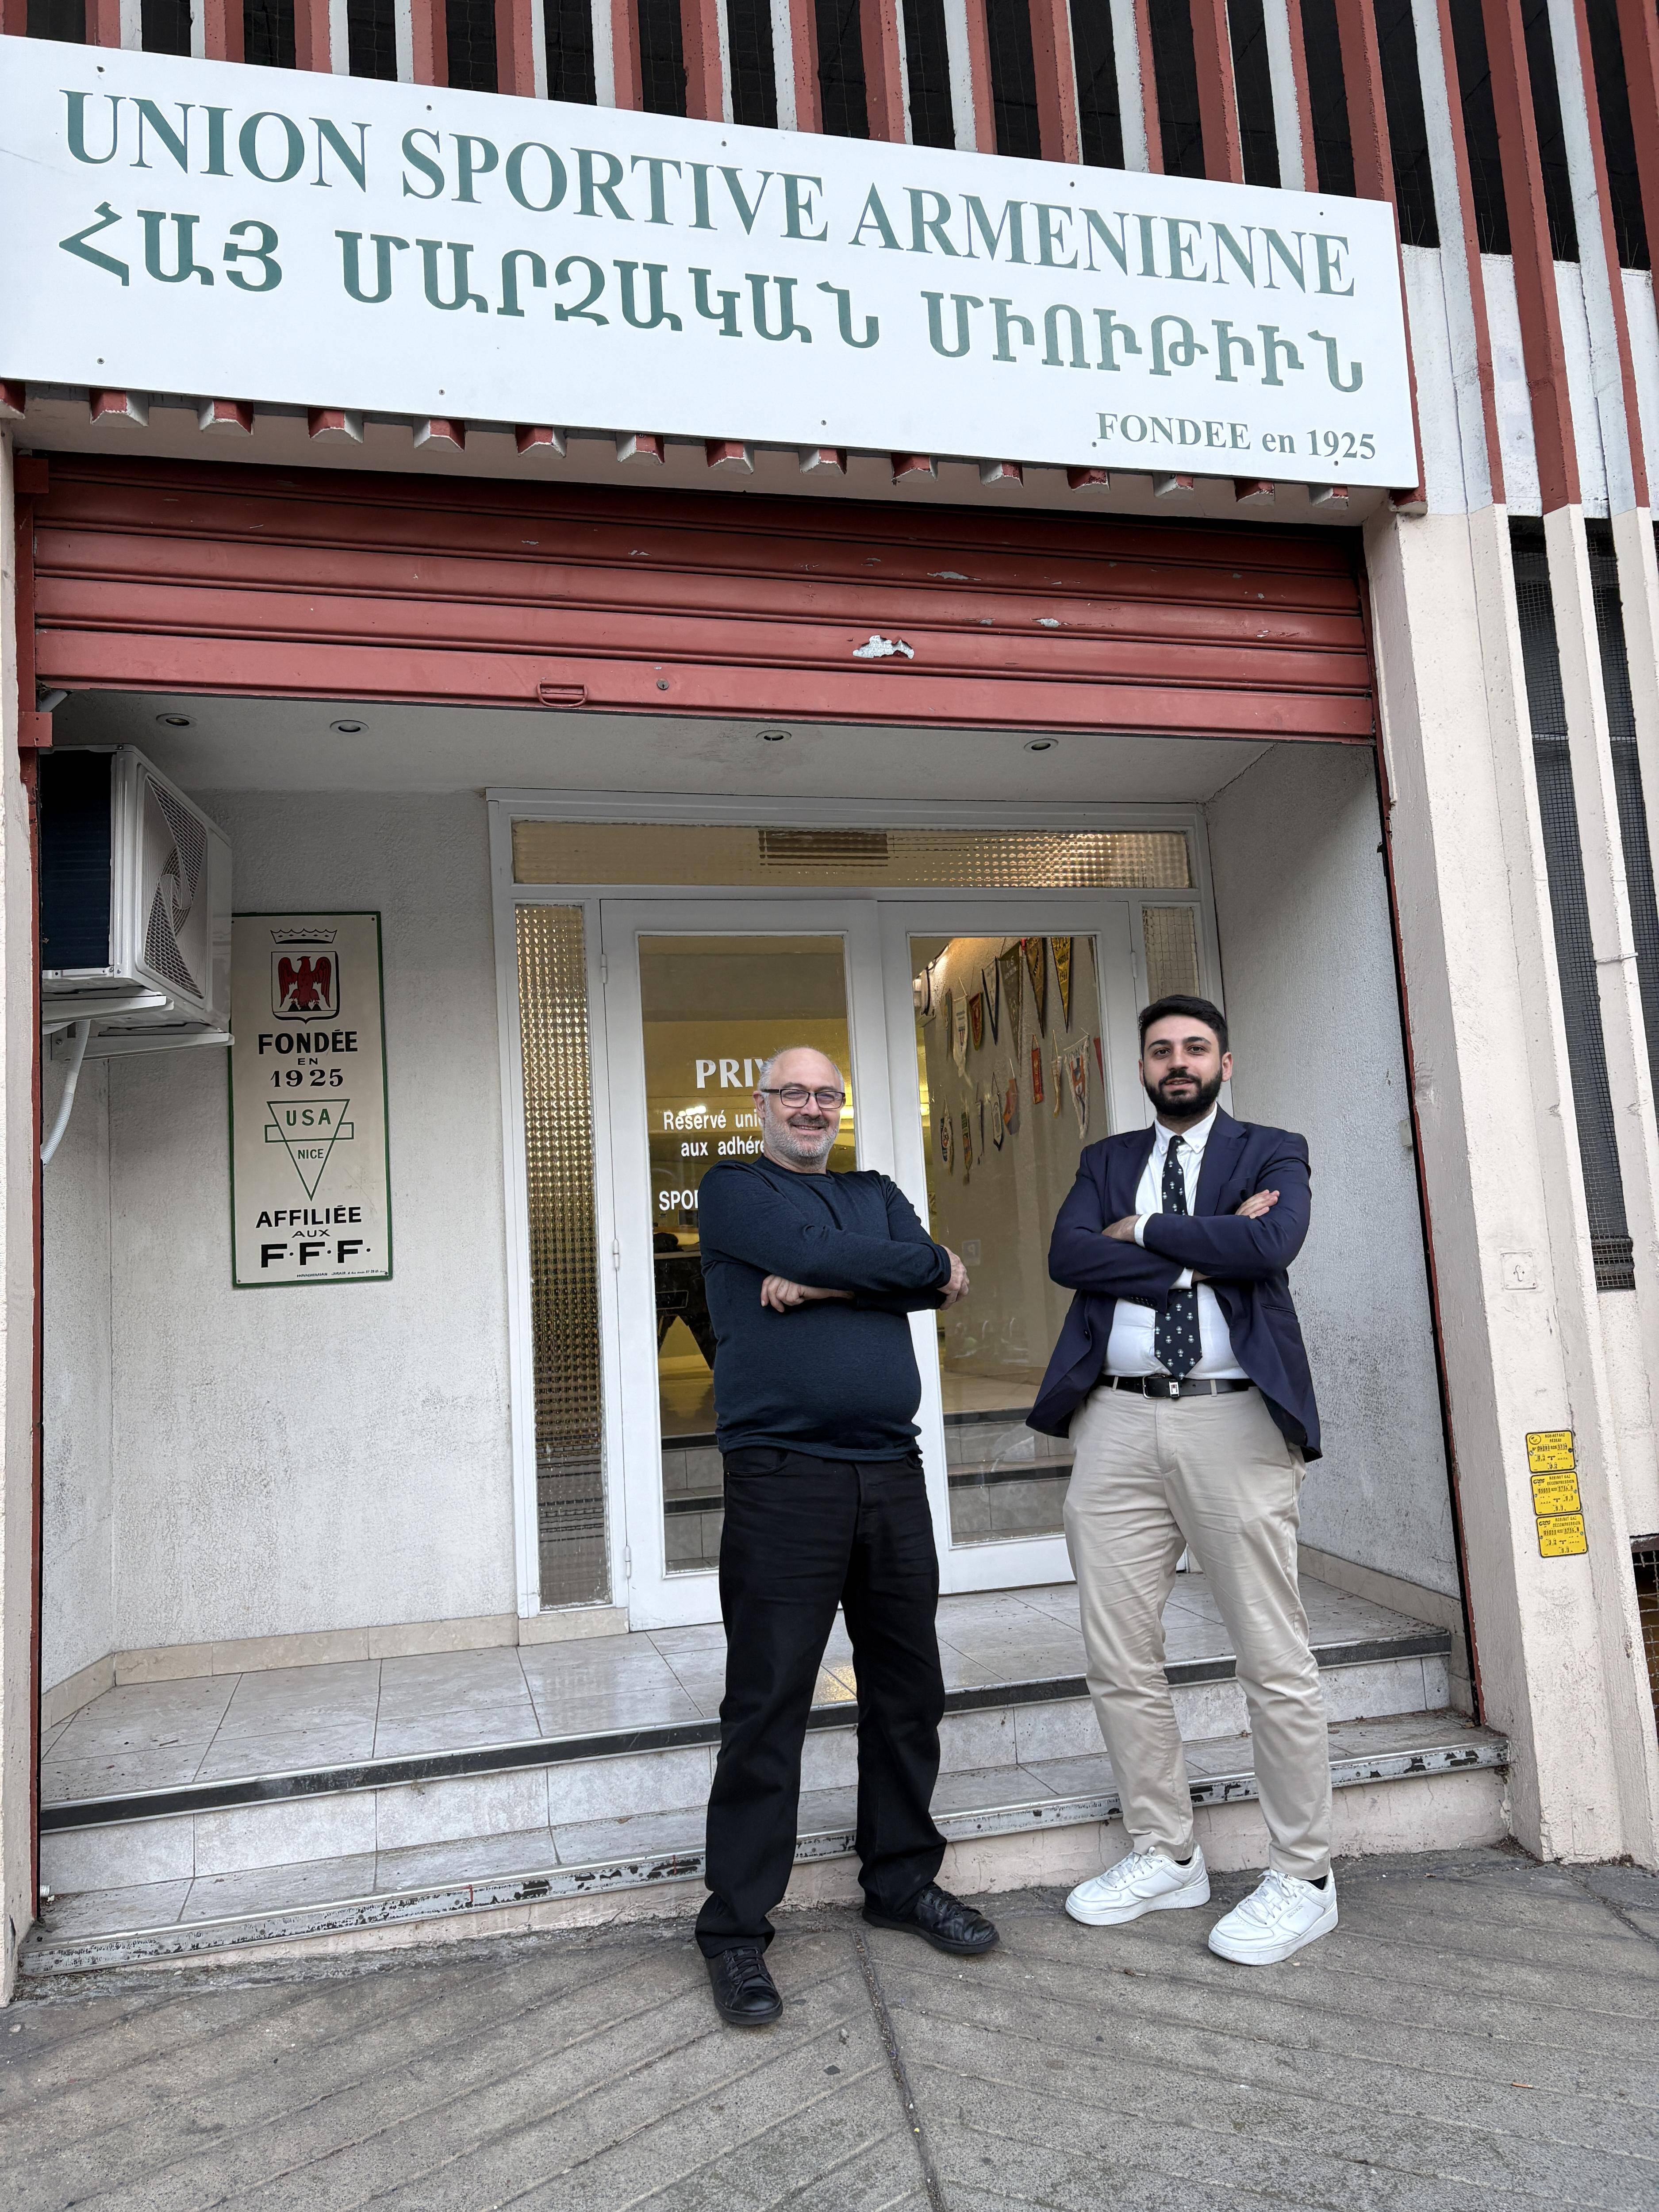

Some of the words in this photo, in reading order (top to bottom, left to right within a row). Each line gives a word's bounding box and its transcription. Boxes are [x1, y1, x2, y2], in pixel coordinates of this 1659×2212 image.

[59, 89, 373, 193] UNION
[402, 128, 828, 242] SPORTIVE
[848, 182, 1354, 296] ARMENIENNE
[59, 201, 282, 292] ՀԱՅ
[334, 230, 879, 349] ՄԱՐԶԱԿԱՆ
[1095, 412, 1251, 450] FONDEE
[1262, 433, 1296, 454] en
[1306, 430, 1375, 459] 1925
[258, 1029, 357, 1054] FONDÉE
[270, 1068, 343, 1087] 1925
[286, 1108, 331, 1126] USA
[298, 1149, 324, 1160] NICE
[681, 1141, 708, 1156] aux
[256, 1205, 362, 1229] AFFILIÉE
[292, 1229, 330, 1238] AUX
